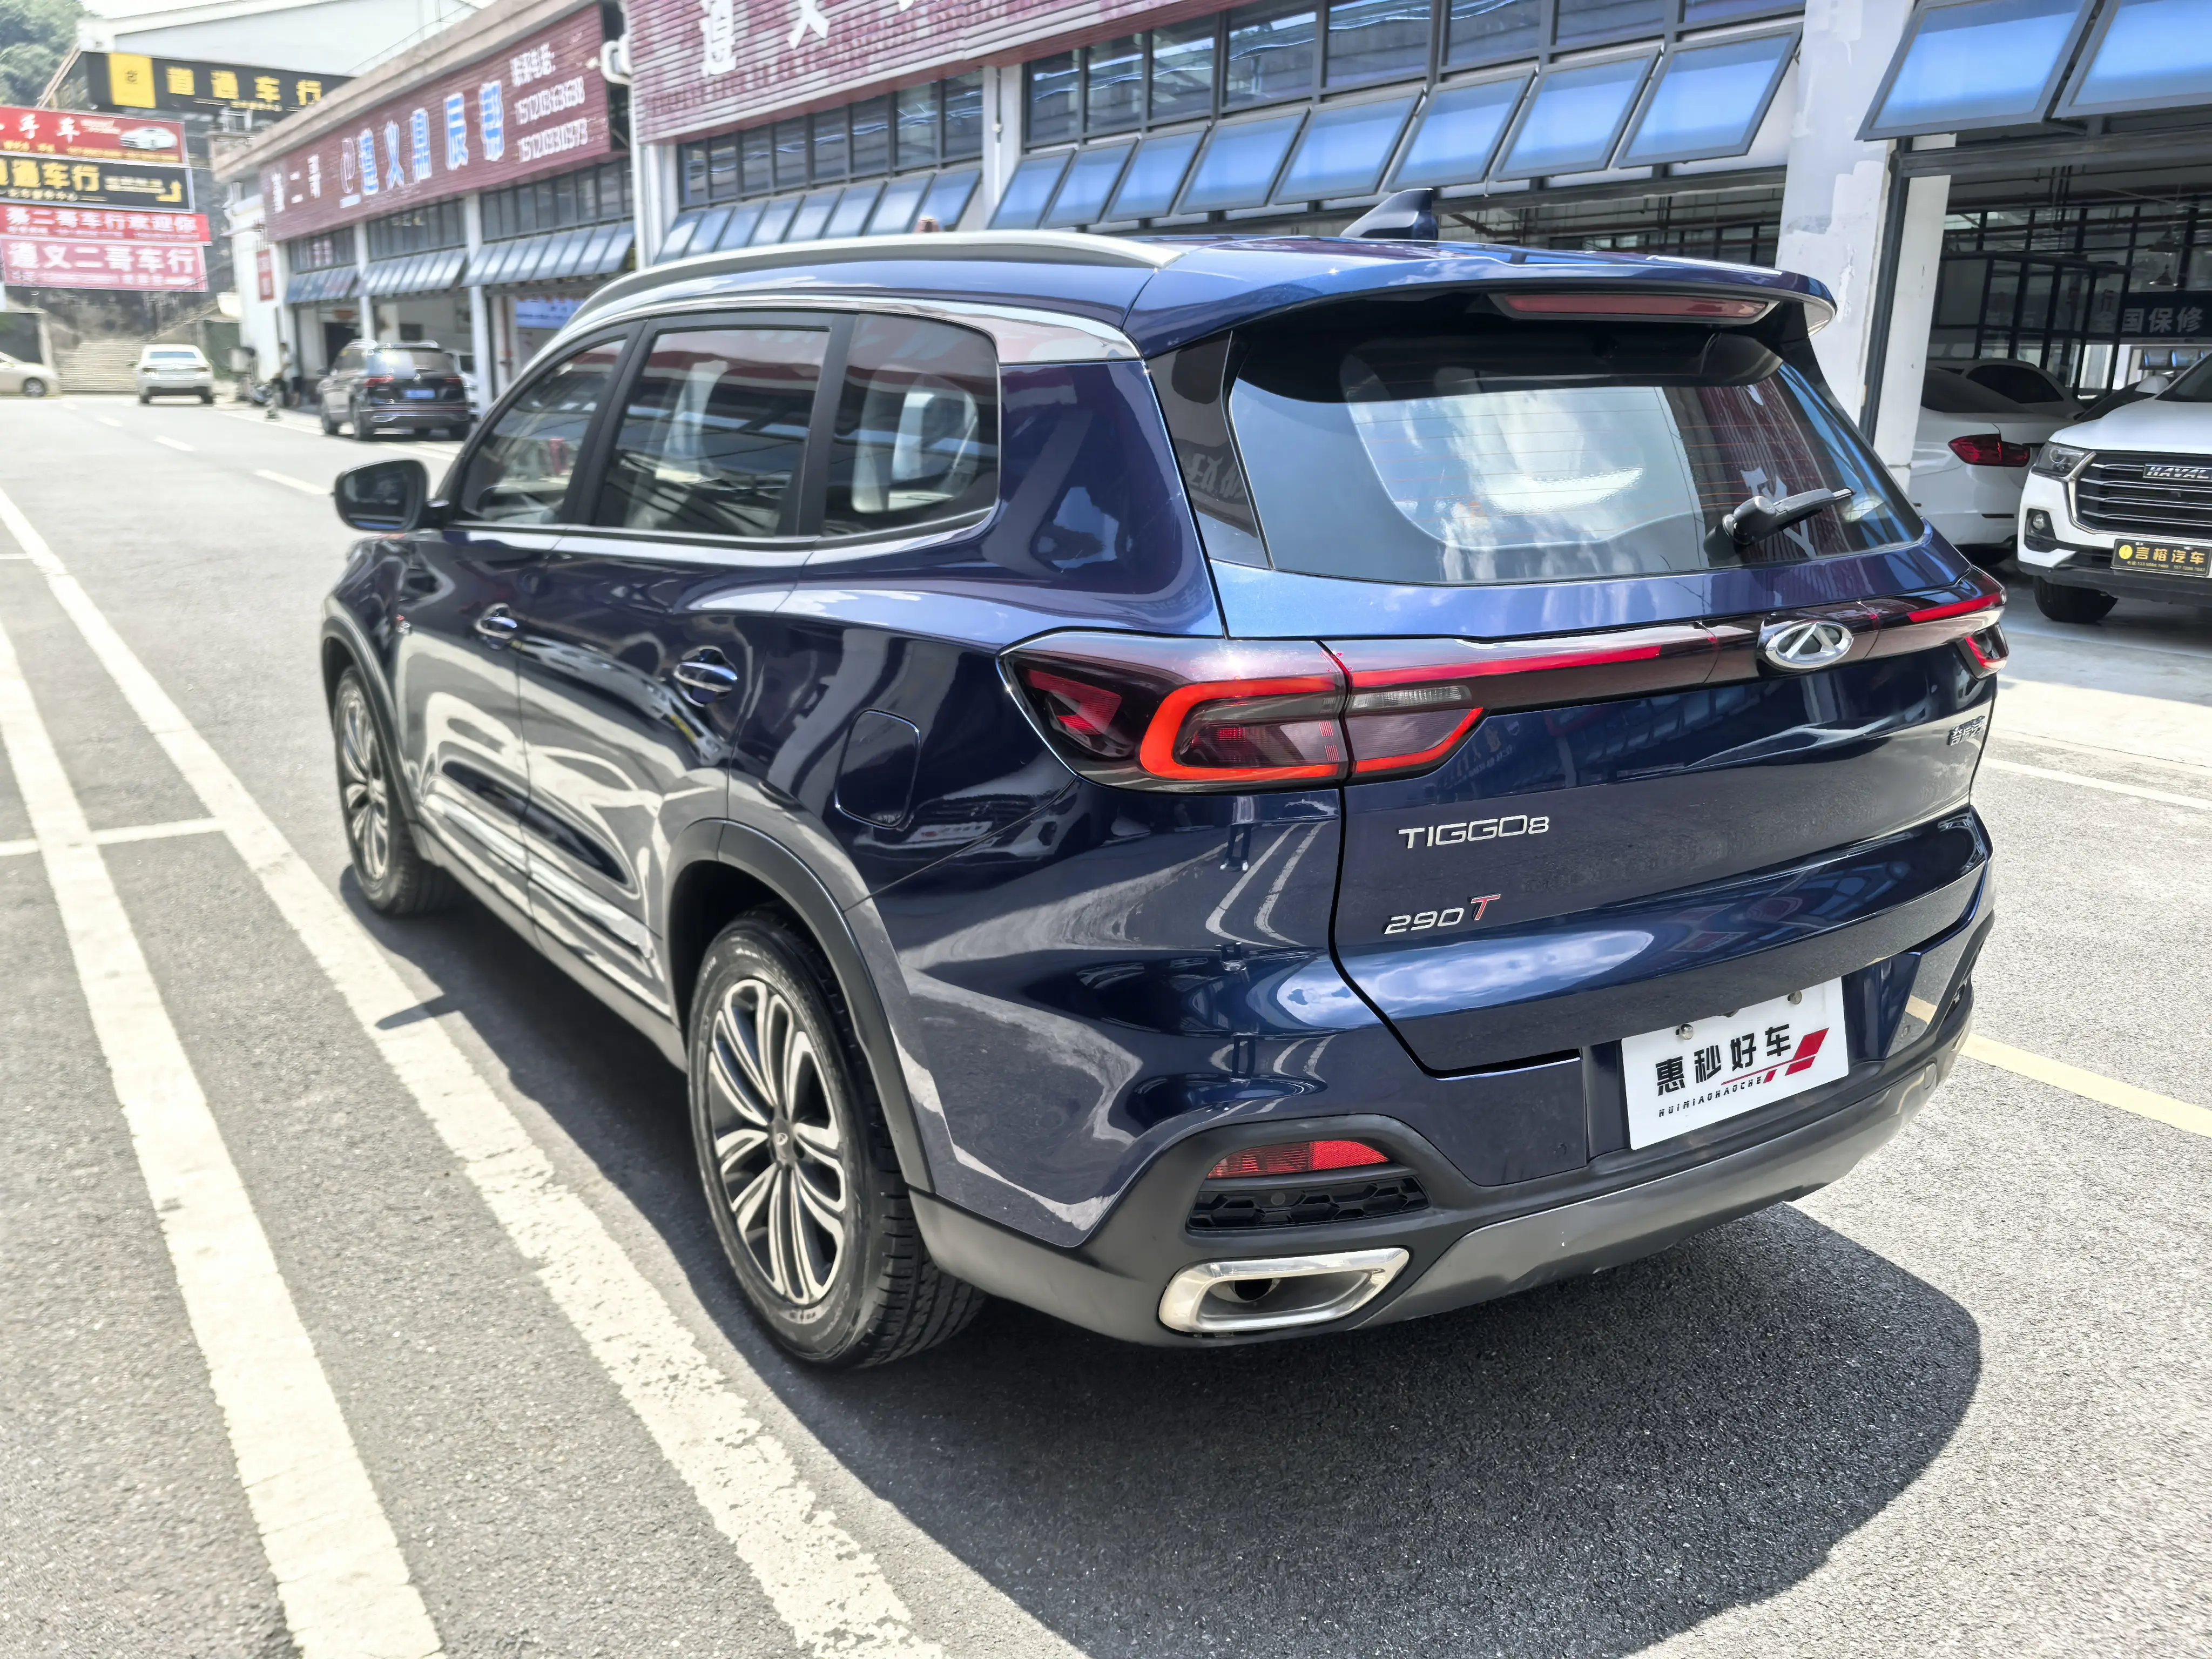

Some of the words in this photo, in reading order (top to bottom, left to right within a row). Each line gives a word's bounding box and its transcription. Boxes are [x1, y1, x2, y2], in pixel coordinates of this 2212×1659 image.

[2147, 467, 2206, 479] HAVAL
[1655, 1023, 1791, 1096] 惠秒好车
[1658, 1076, 1762, 1117] HUIMIAOHAOCHE
